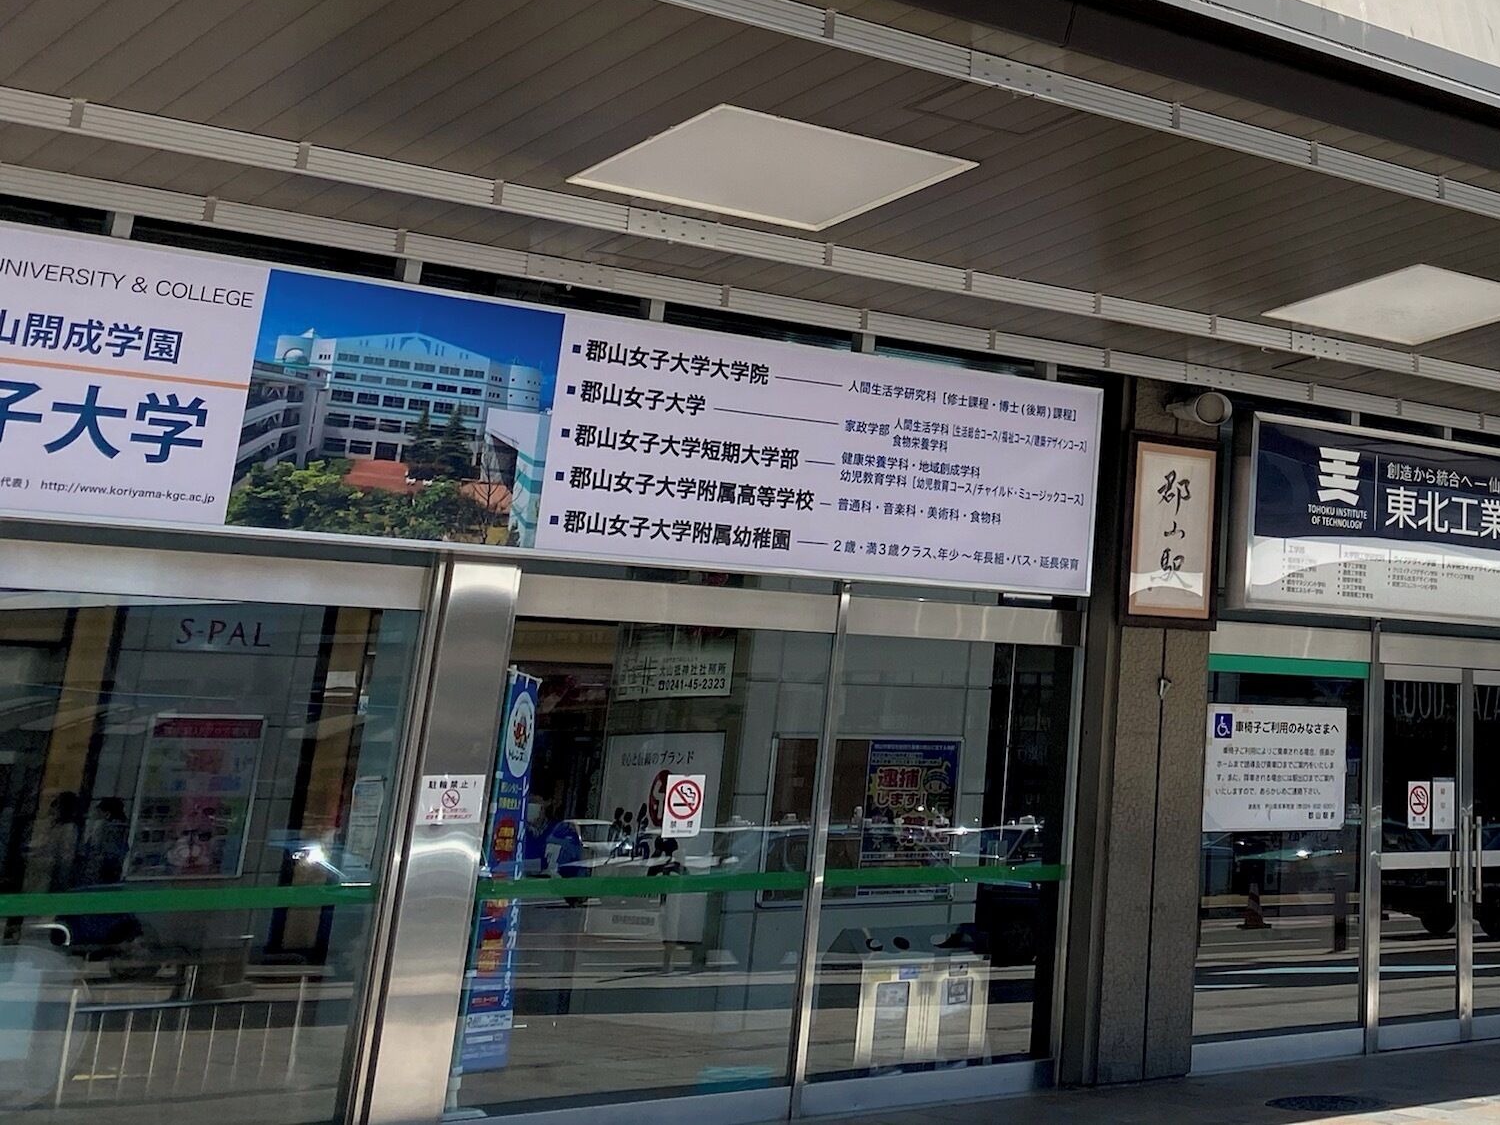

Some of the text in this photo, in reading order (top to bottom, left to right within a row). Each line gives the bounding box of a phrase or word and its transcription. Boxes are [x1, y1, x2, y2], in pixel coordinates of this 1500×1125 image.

[0, 258, 255, 309] NIVERSITY & COLLEGE
[584, 339, 770, 385] 郡山女子大学大学院
[579, 379, 706, 417] 郡山女子大学
[848, 379, 937, 404] 人間生活学研究科
[845, 418, 890, 437] 家政学部
[894, 417, 949, 436] 人間生活学科
[573, 424, 800, 471] 郡山女子大学短期大学部
[892, 434, 948, 453] 食物栄養学科
[568, 466, 816, 512] 郡山女子大学附属高等学校
[839, 469, 908, 489] 幼児教育学科
[40, 480, 215, 505] http://www.koriyama-kgc.ac.jp
[1307, 503, 1368, 520] TOHOKU INSTITUTE
[1311, 515, 1364, 530] OF TECHNOLOGY
[563, 510, 792, 552] 郡山女子大学附属幼稚園
[175, 618, 271, 648] S-PAL
[1235, 721, 1340, 735] 車椅子ご利用のみなさまへ
